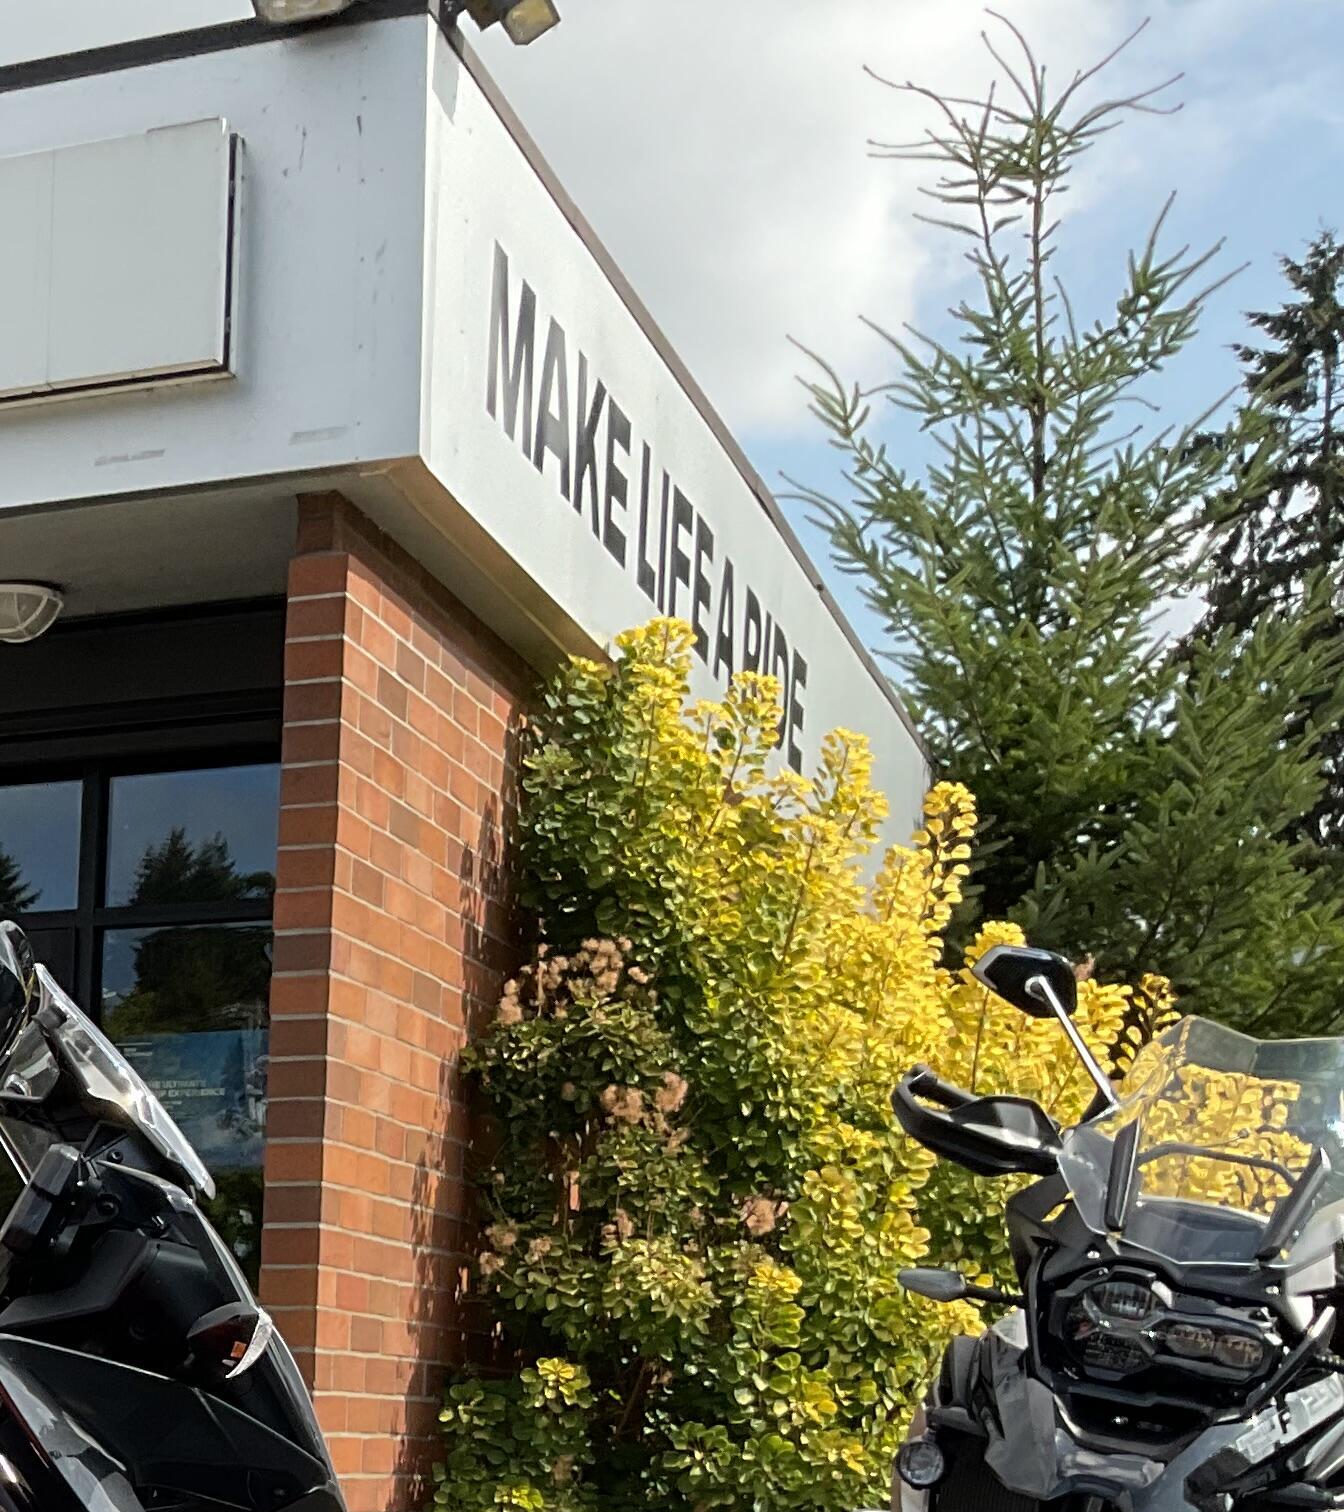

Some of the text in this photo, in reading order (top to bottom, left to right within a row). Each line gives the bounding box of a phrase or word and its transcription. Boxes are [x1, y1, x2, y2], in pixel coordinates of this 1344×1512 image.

[487, 239, 632, 570] MAKE
[636, 440, 714, 666] LIFE
[713, 556, 736, 681] A
